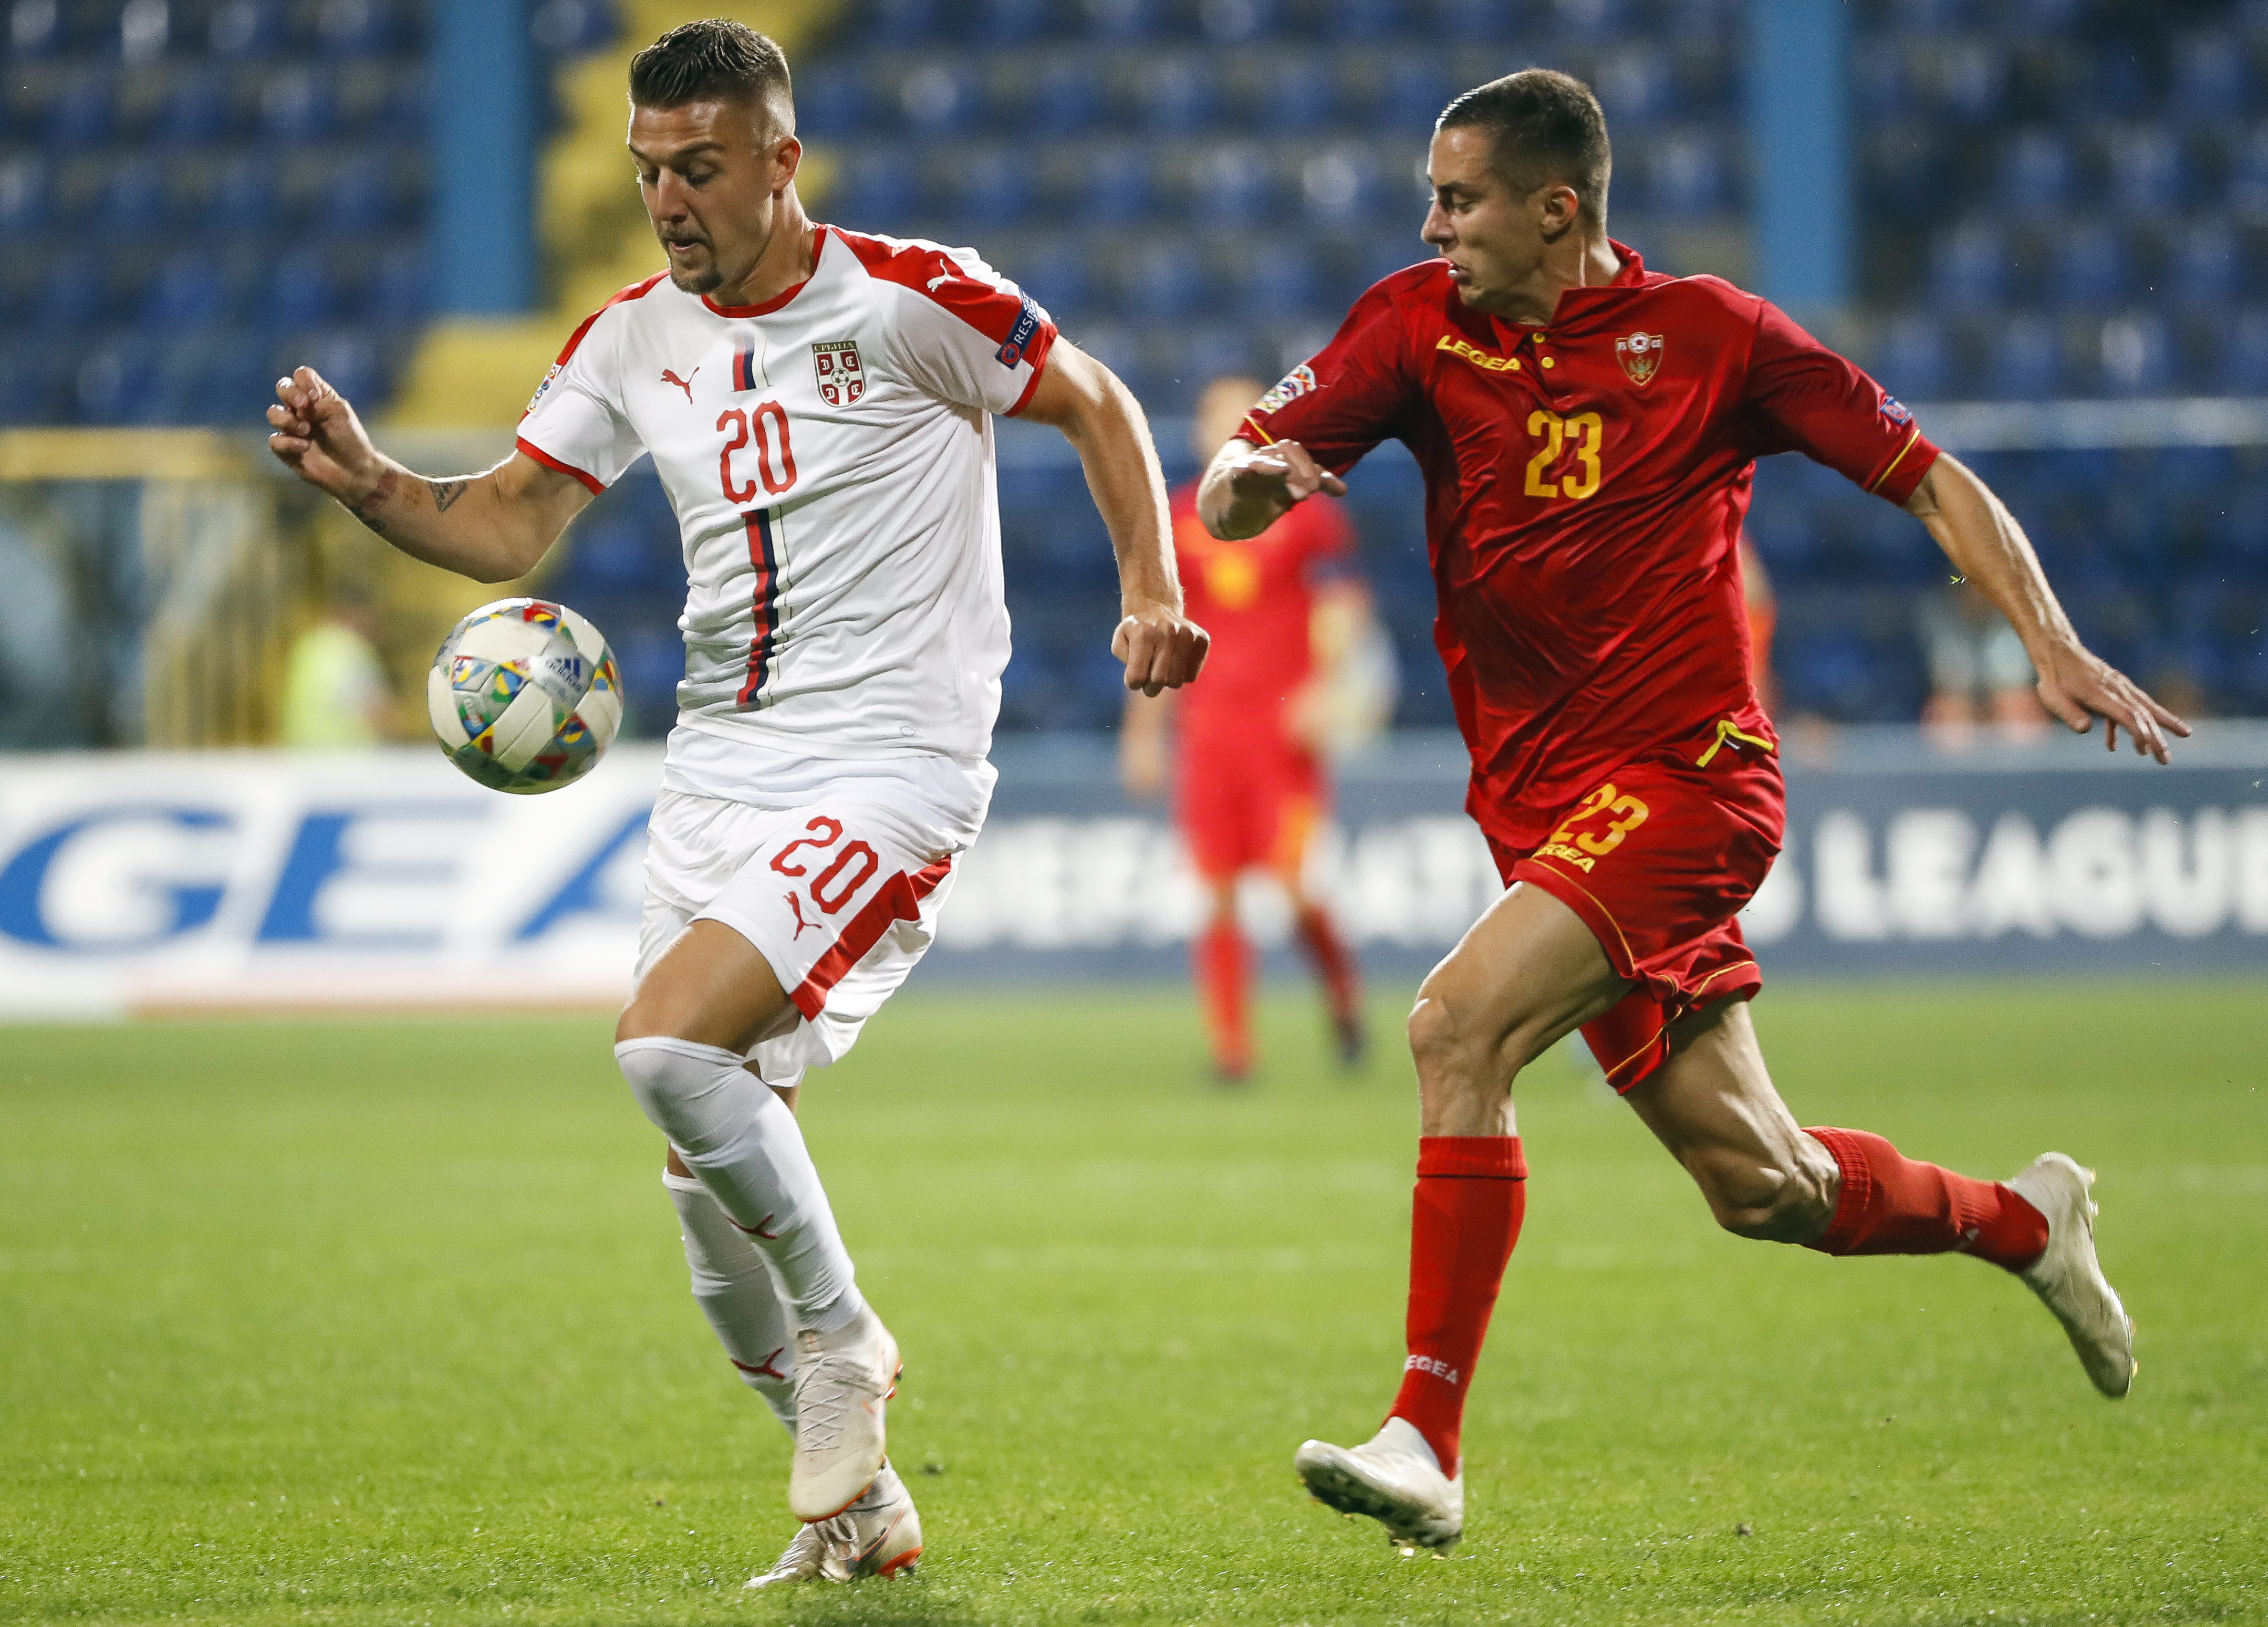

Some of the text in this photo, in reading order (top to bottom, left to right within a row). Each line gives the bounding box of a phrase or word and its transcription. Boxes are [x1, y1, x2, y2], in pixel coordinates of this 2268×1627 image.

[1435, 335, 1521, 371] LEGEA
[716, 400, 797, 504] 20
[1524, 410, 1603, 499] 23
[545, 659, 583, 693] adidas
[1549, 783, 1650, 856] 23
[770, 816, 878, 914] 20
